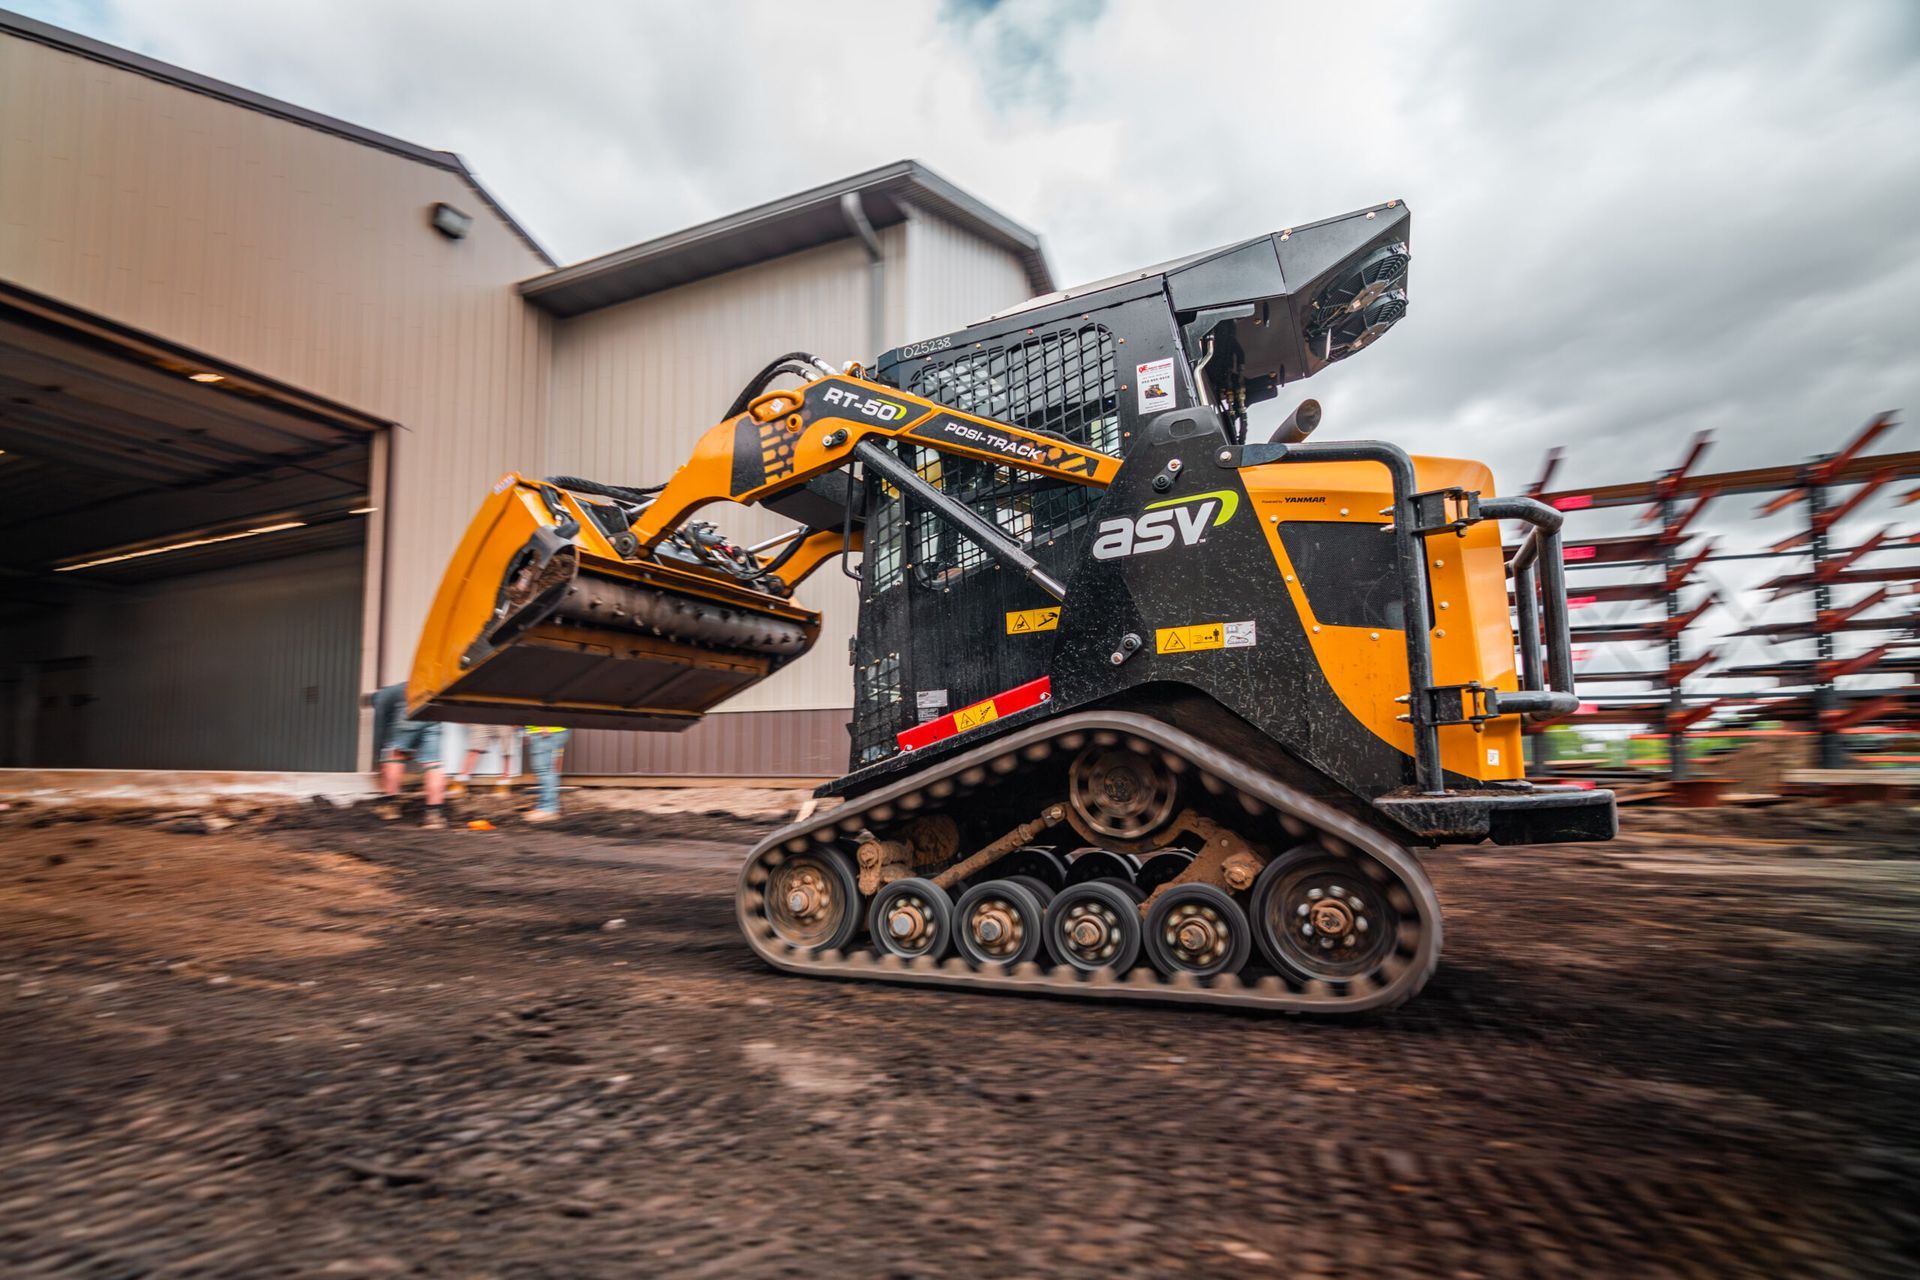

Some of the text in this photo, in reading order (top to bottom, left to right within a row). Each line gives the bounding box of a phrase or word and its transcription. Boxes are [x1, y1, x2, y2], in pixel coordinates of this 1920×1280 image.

[903, 337, 952, 359] 025238
[823, 387, 898, 421] RT-50
[944, 422, 1043, 461] POSI-TRACK
[1284, 496, 1326, 504] YANMAR
